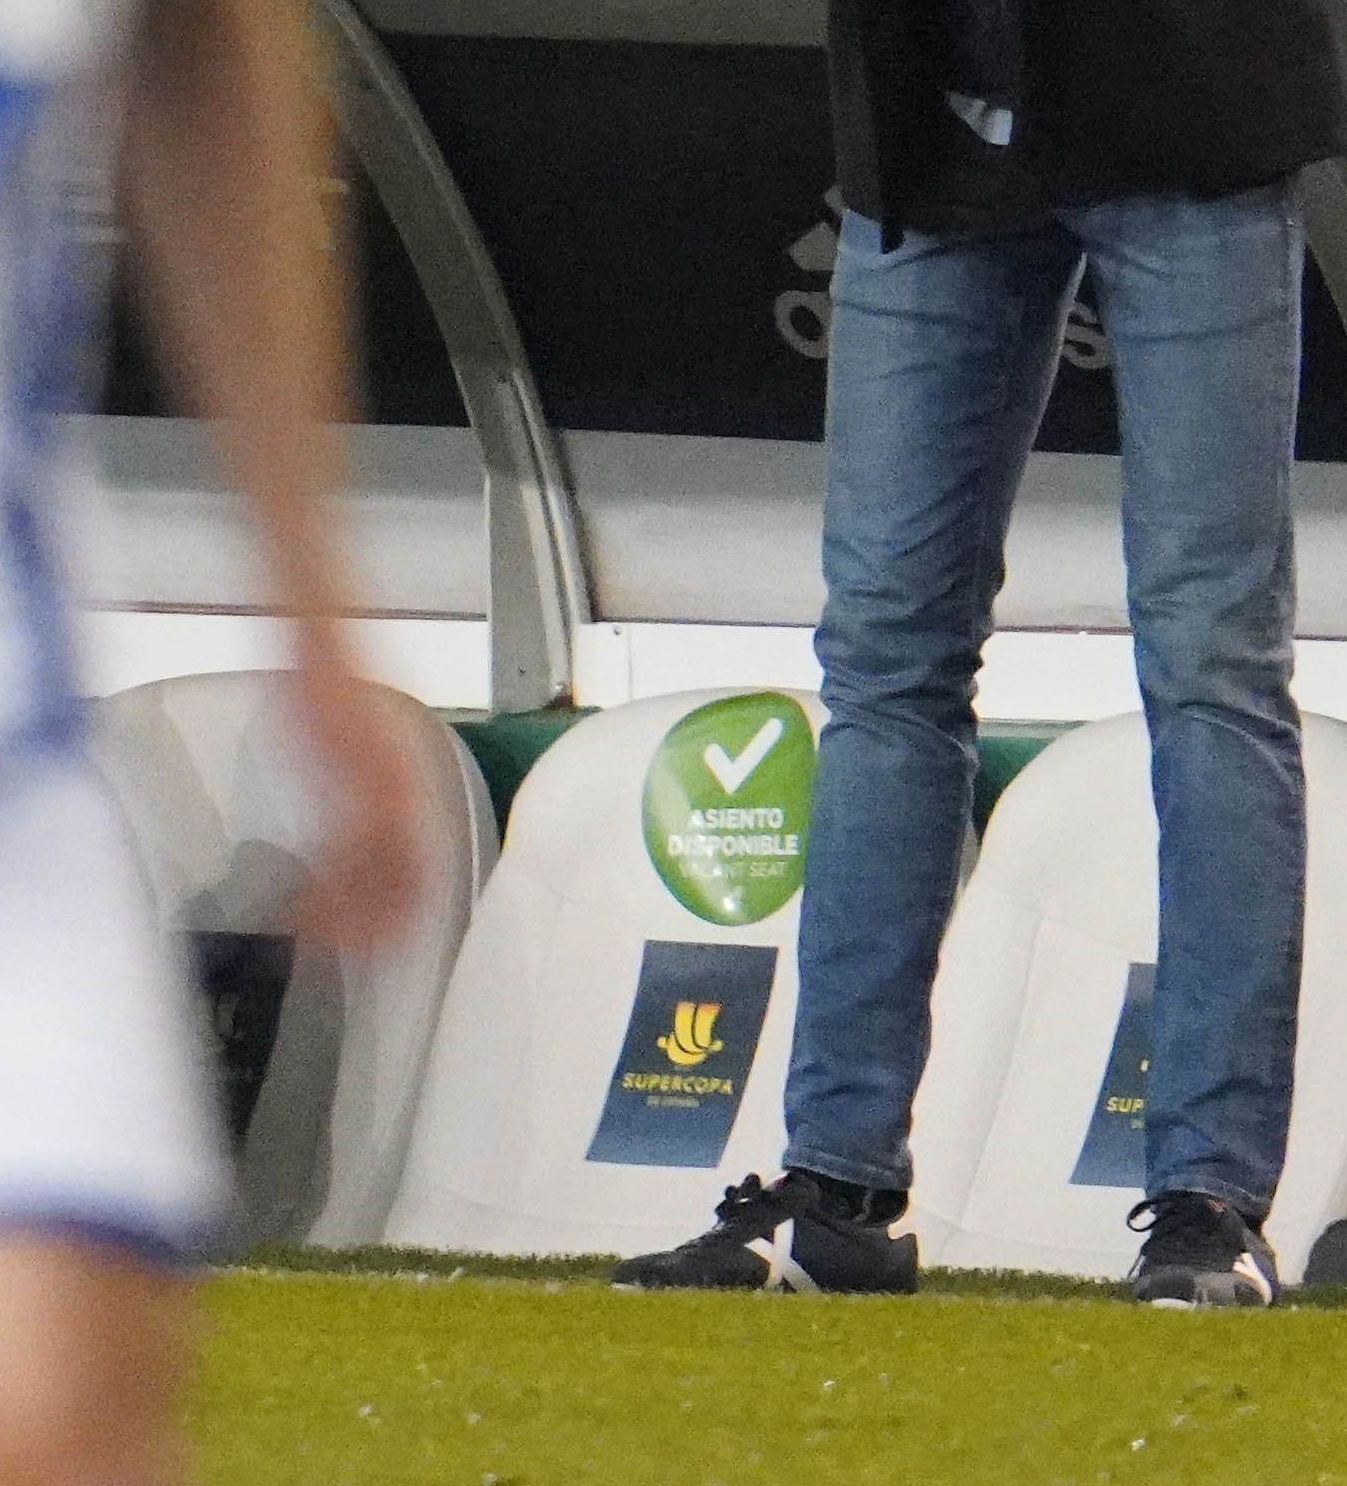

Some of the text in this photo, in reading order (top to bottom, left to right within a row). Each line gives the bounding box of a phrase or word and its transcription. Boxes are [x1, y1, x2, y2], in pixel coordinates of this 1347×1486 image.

[687, 808, 784, 829] ASIENTO
[667, 834, 799, 856] DISPONIBLE
[621, 1071, 733, 1095] SUPERCOPA
